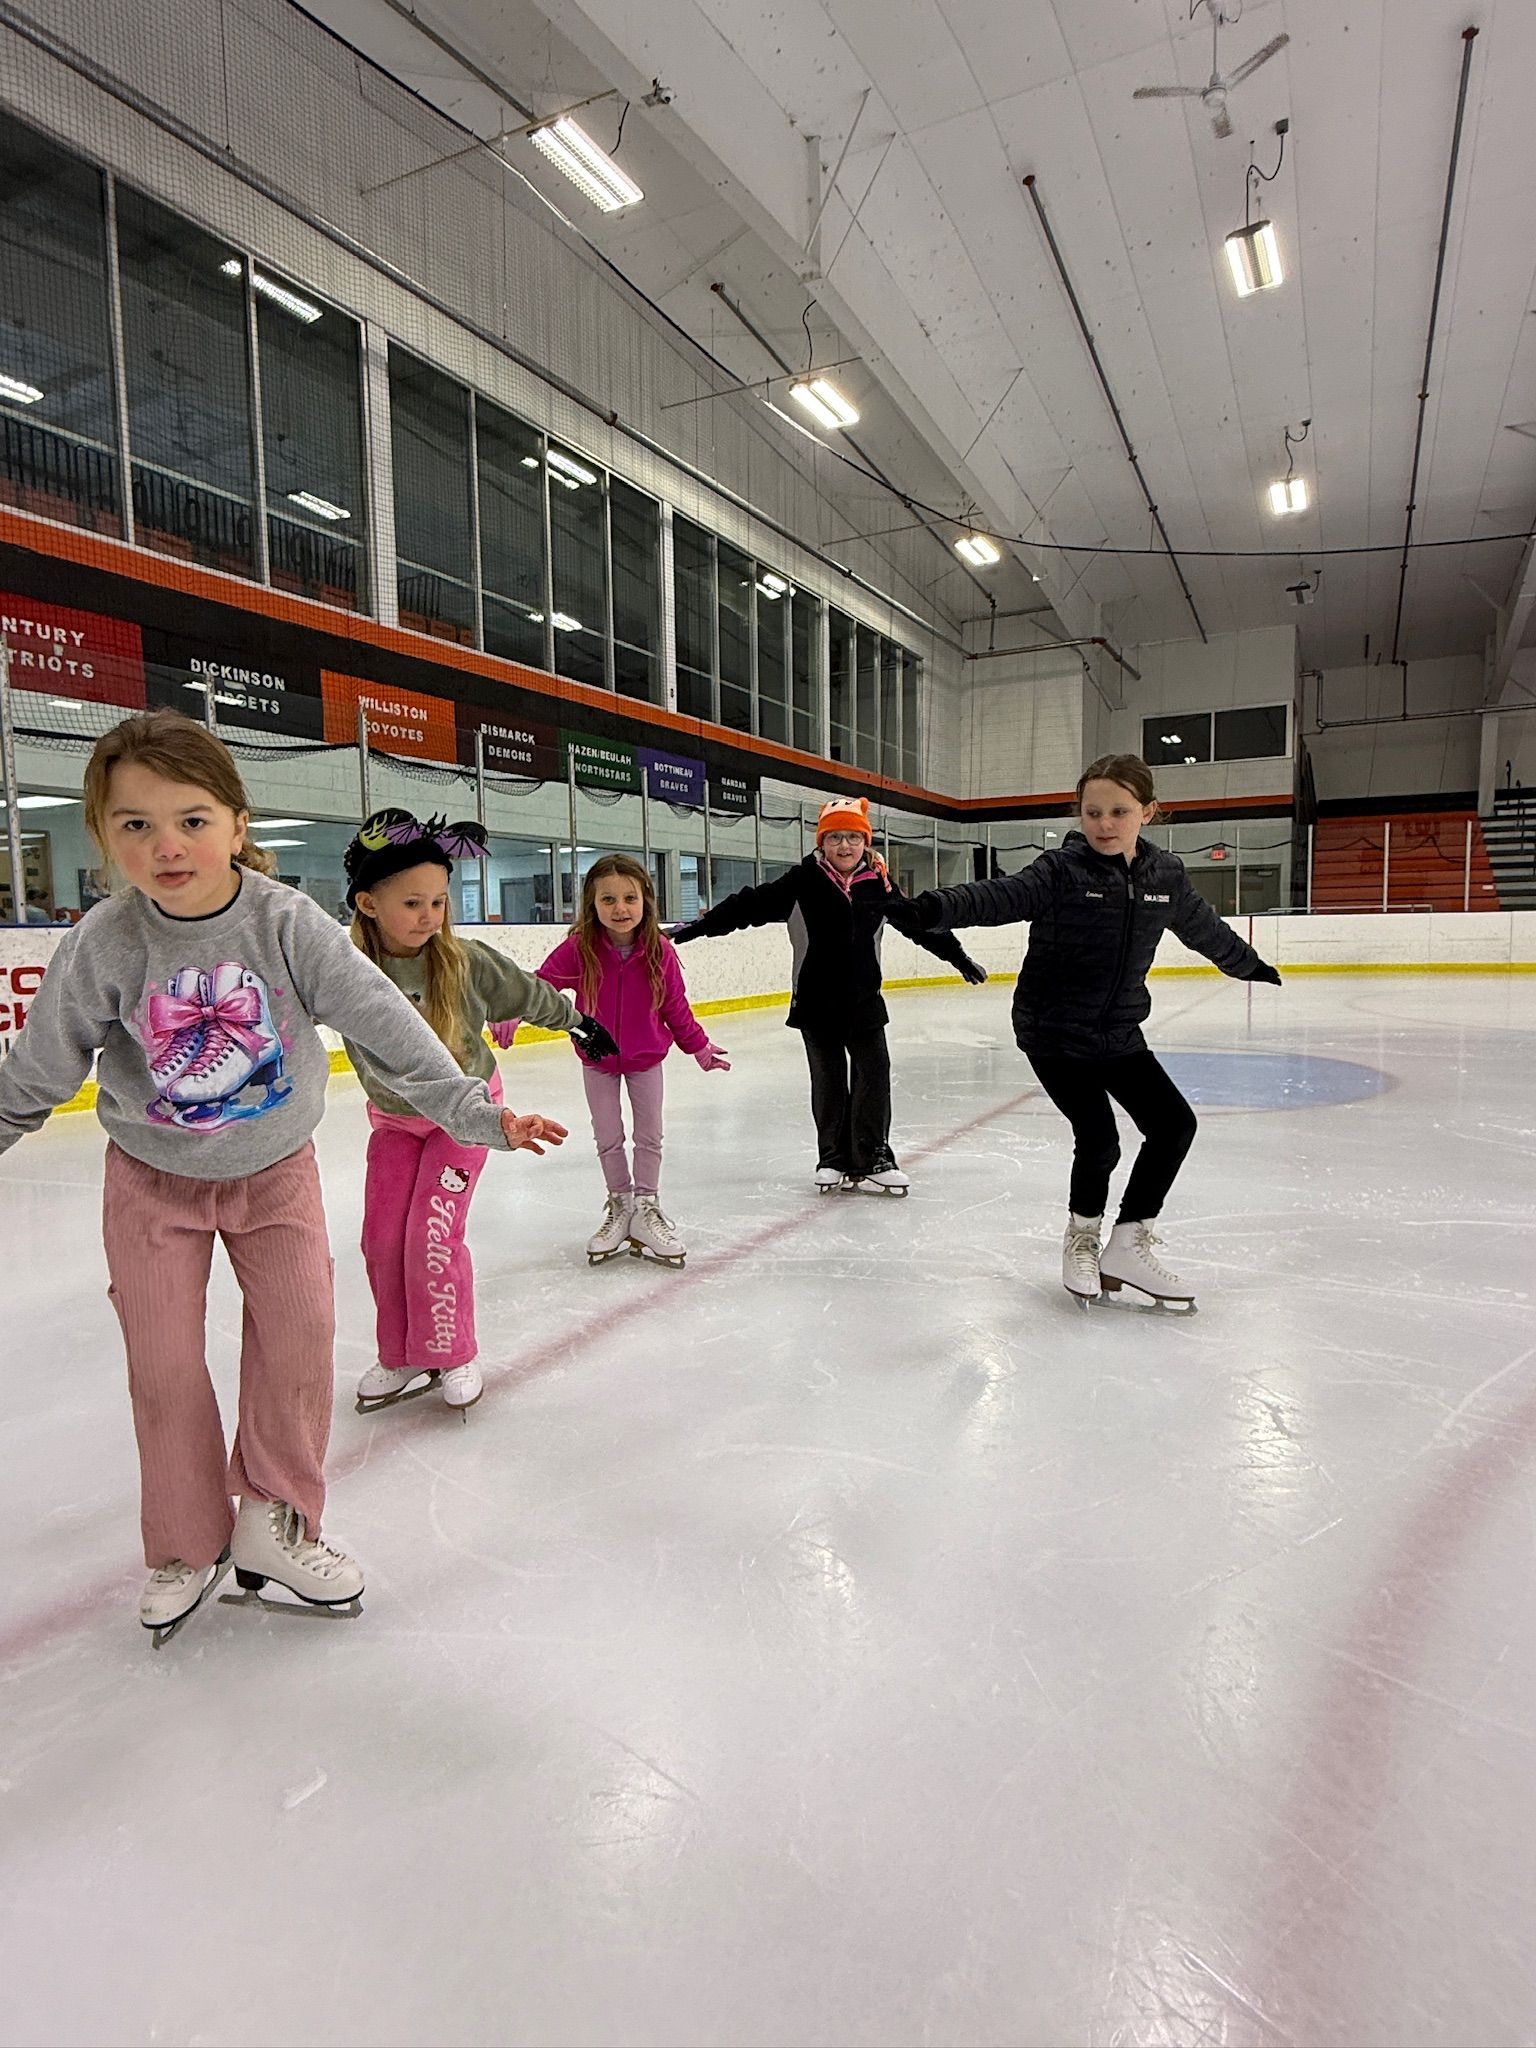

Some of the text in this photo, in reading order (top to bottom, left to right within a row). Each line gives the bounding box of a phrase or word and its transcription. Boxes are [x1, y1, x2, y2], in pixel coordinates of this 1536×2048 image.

[190, 658, 285, 692] DICKINSON
[358, 695, 428, 721] WILLISTON
[366, 721, 424, 743] COYOTES
[480, 723, 536, 746] BISMARCK
[488, 745, 532, 763] DEMONS
[575, 763, 632, 782] NORTHSTARS
[654, 762, 693, 778] BOTTINEAU
[660, 779, 689, 793] BRAVES
[425, 1195, 457, 1354] Hello Kitty
